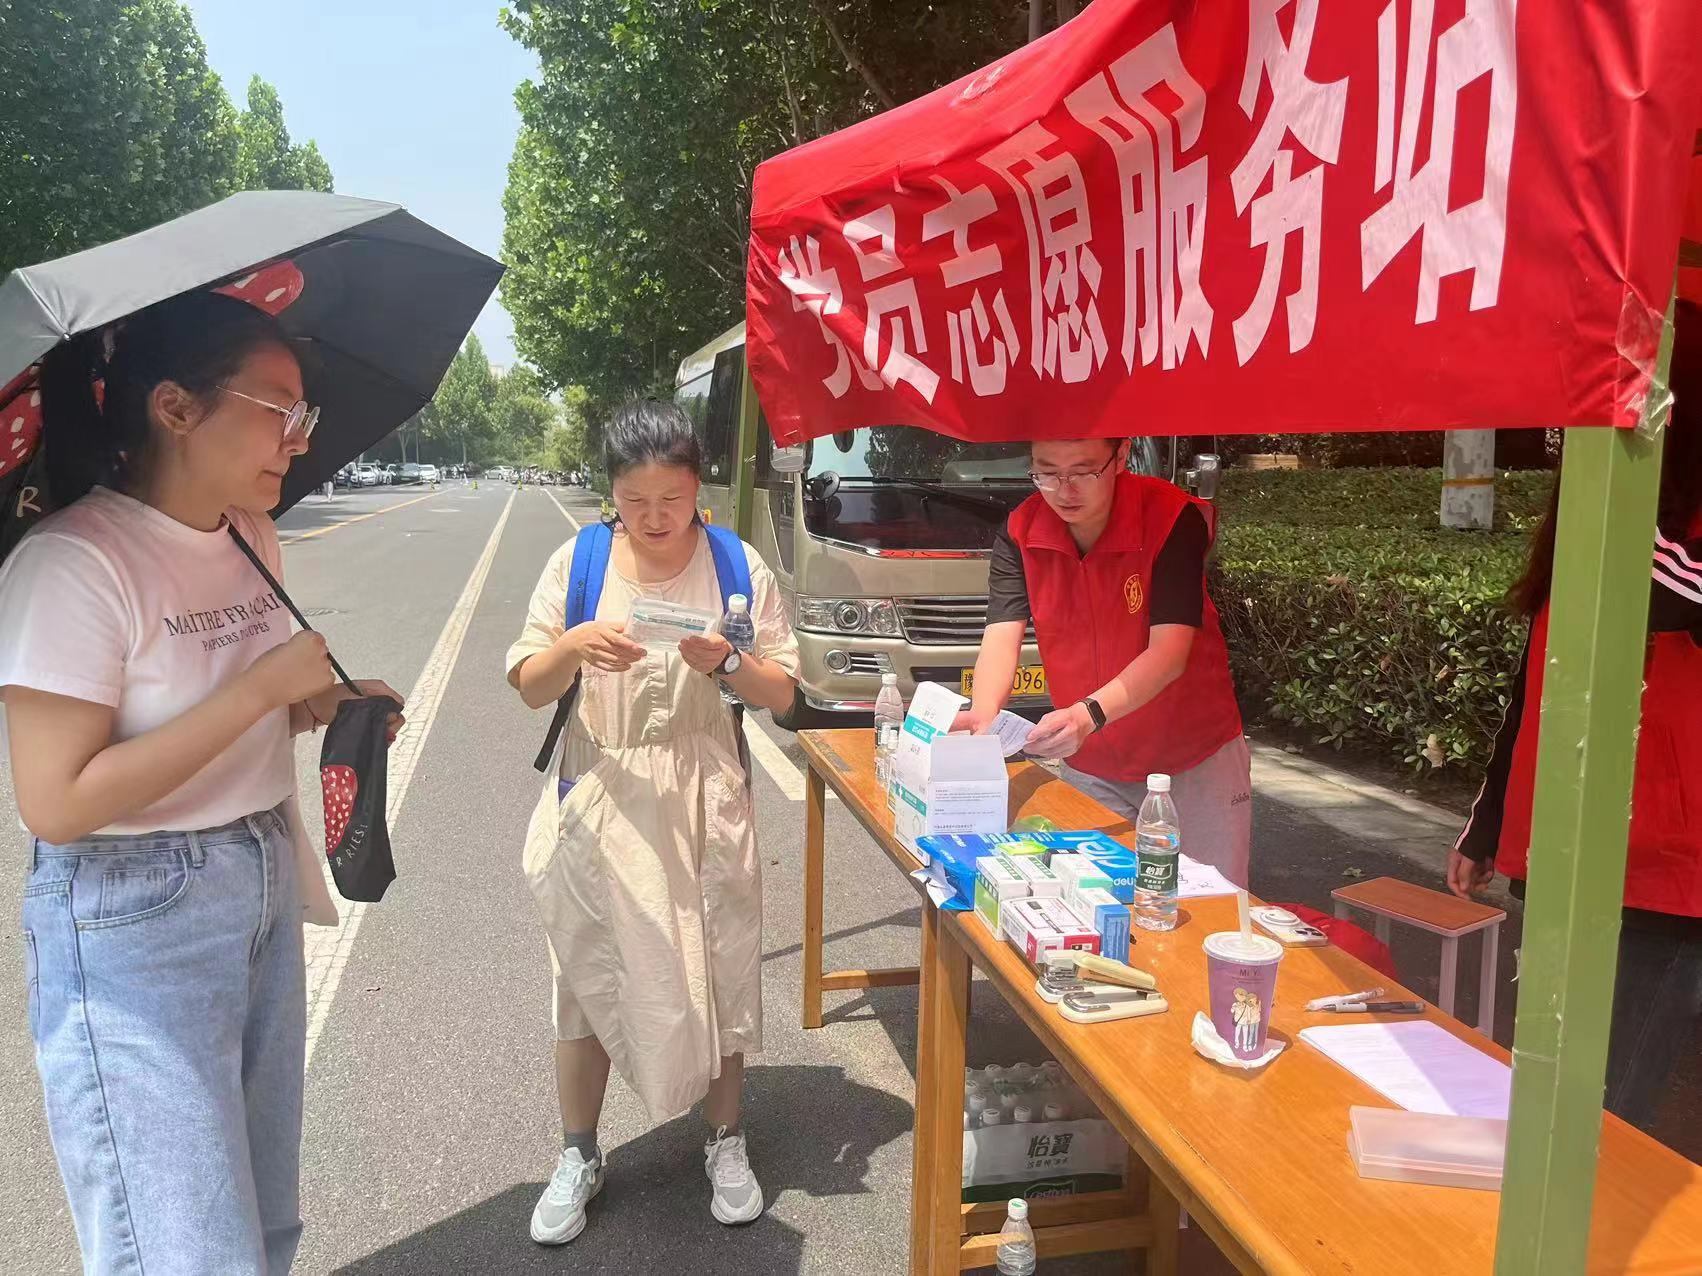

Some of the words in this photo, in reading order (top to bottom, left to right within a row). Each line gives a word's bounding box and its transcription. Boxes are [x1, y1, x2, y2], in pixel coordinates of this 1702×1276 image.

[777, 0, 1517, 404] 党员志愿服务站
